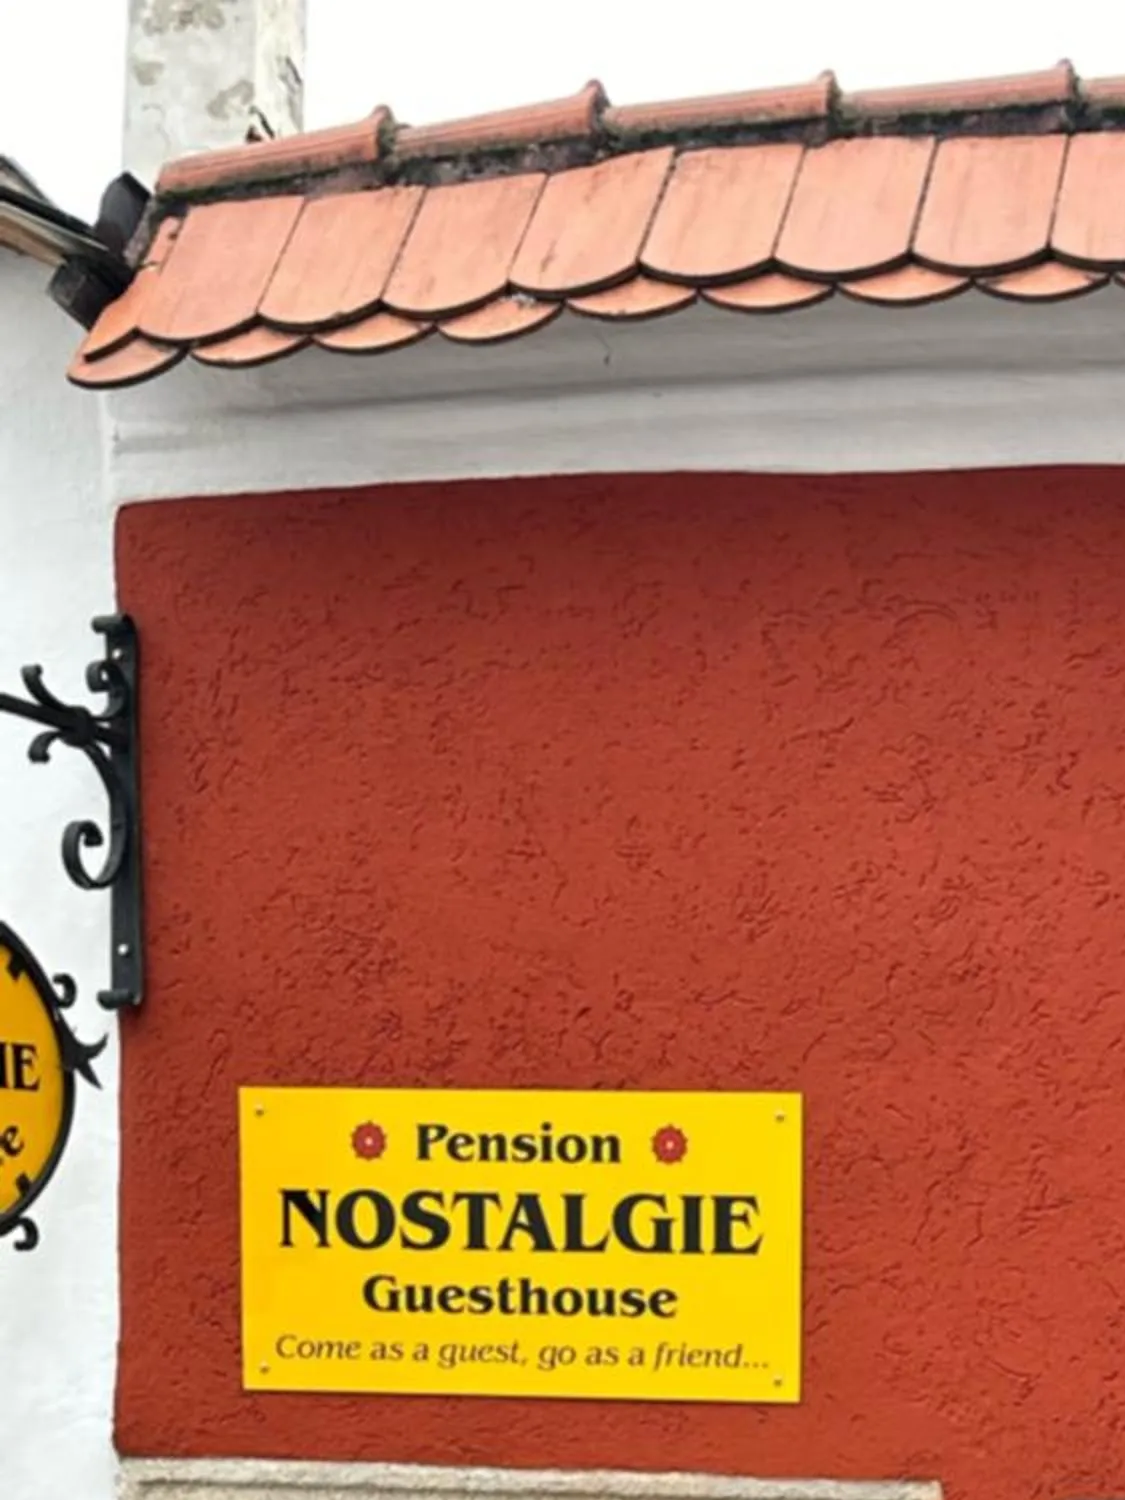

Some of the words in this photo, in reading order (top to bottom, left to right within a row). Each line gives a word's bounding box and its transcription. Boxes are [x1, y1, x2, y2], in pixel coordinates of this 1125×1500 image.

[416, 1122, 621, 1163] Pension
[278, 1188, 763, 1255] NOSTALGIE
[362, 1274, 678, 1318] Guesthouse
[275, 1334, 361, 1360] Come
[369, 1342, 404, 1361] as
[412, 1343, 429, 1361] a
[438, 1341, 528, 1369] guest,
[538, 1346, 577, 1371] go
[585, 1347, 619, 1366] as
[627, 1348, 645, 1366] a
[653, 1341, 770, 1372] friend...
